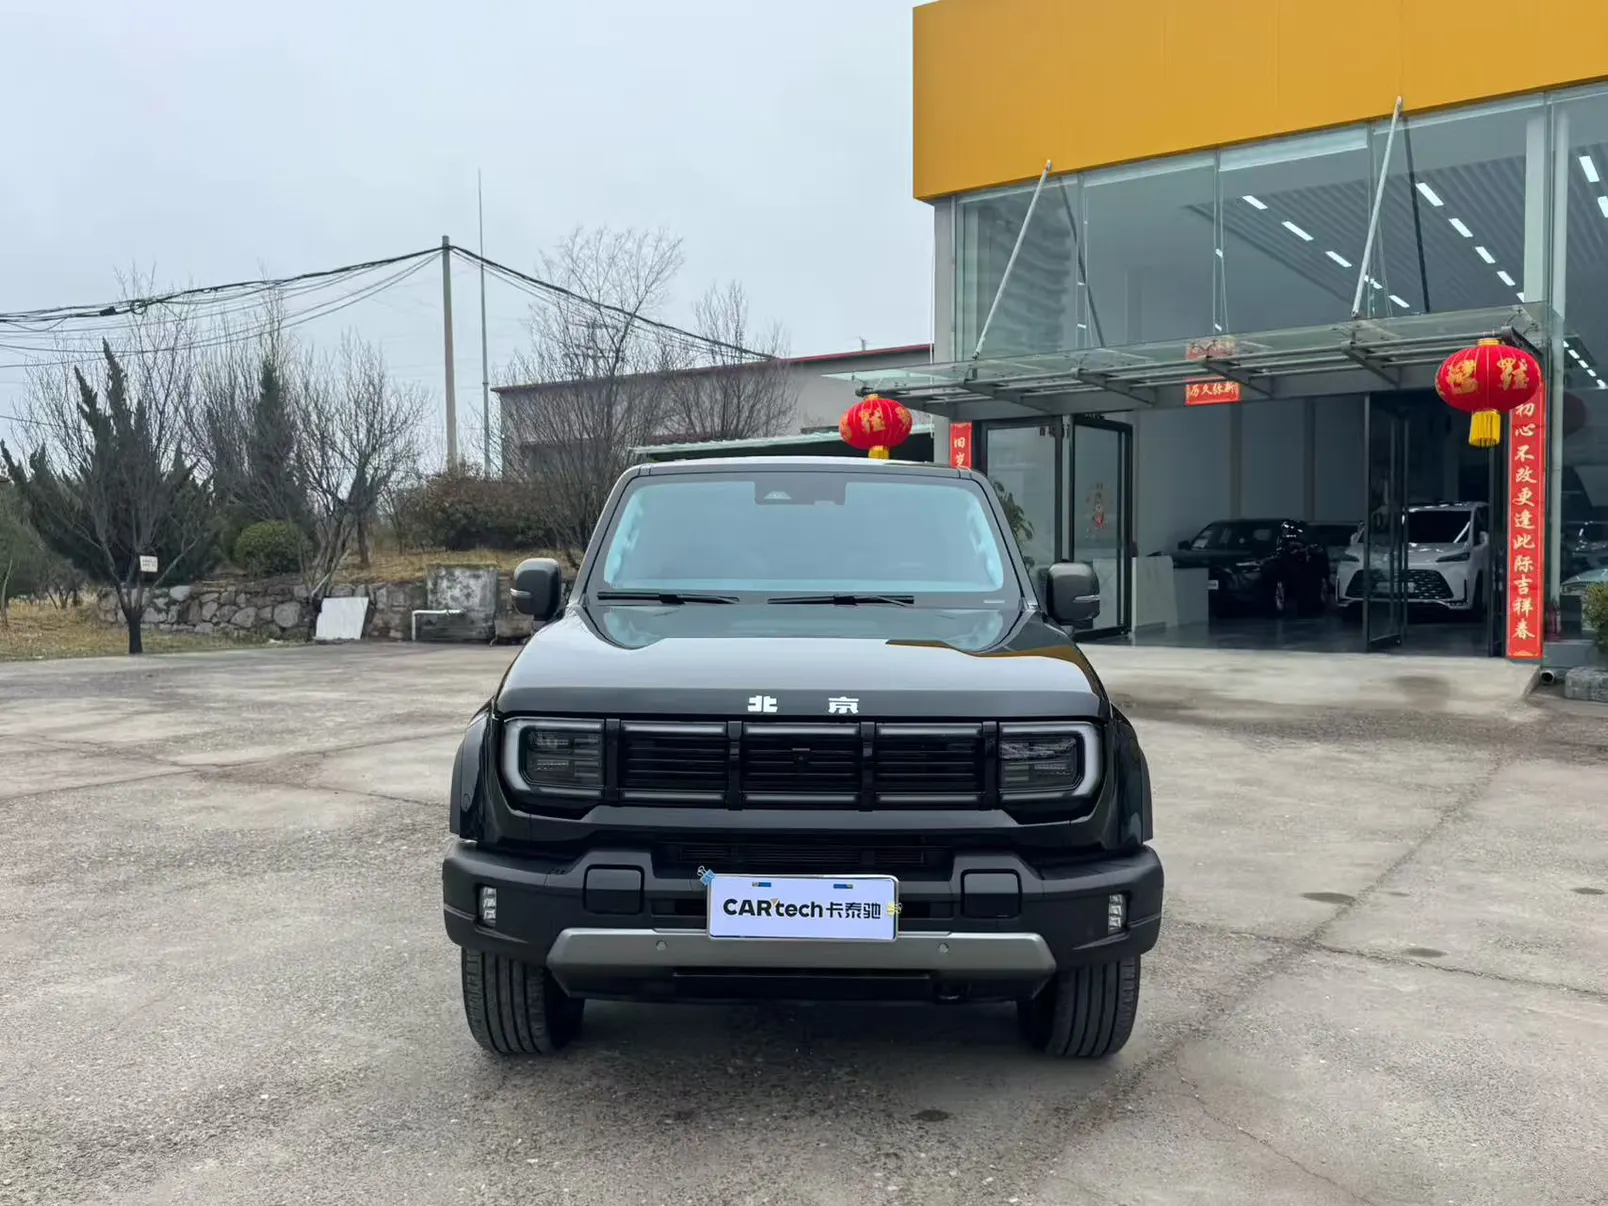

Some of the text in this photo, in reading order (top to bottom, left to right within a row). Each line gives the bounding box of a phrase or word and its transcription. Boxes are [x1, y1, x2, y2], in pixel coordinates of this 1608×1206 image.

[747, 695, 859, 714] 北京
[723, 899, 881, 919] CARtech 卡泰驰
